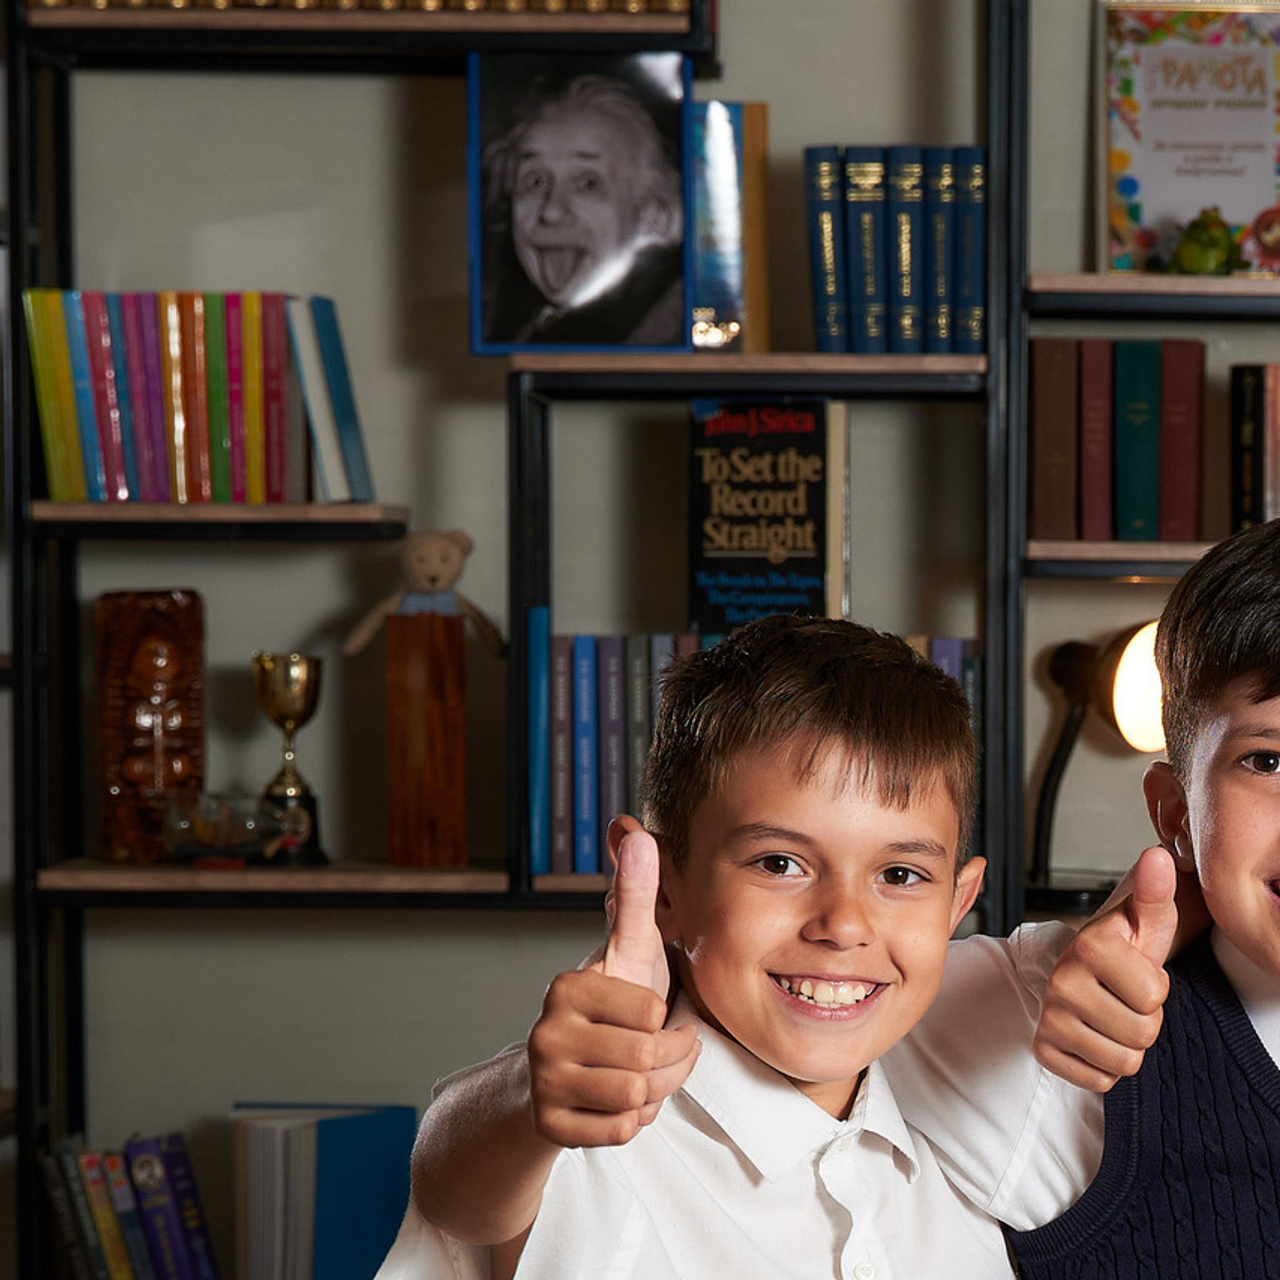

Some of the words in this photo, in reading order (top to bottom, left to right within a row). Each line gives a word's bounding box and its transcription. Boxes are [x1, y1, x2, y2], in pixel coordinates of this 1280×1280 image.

[694, 447, 730, 482] To
[730, 447, 776, 482] Set
[777, 447, 823, 482] the
[711, 481, 808, 516] Record
[703, 516, 818, 564] Straight
